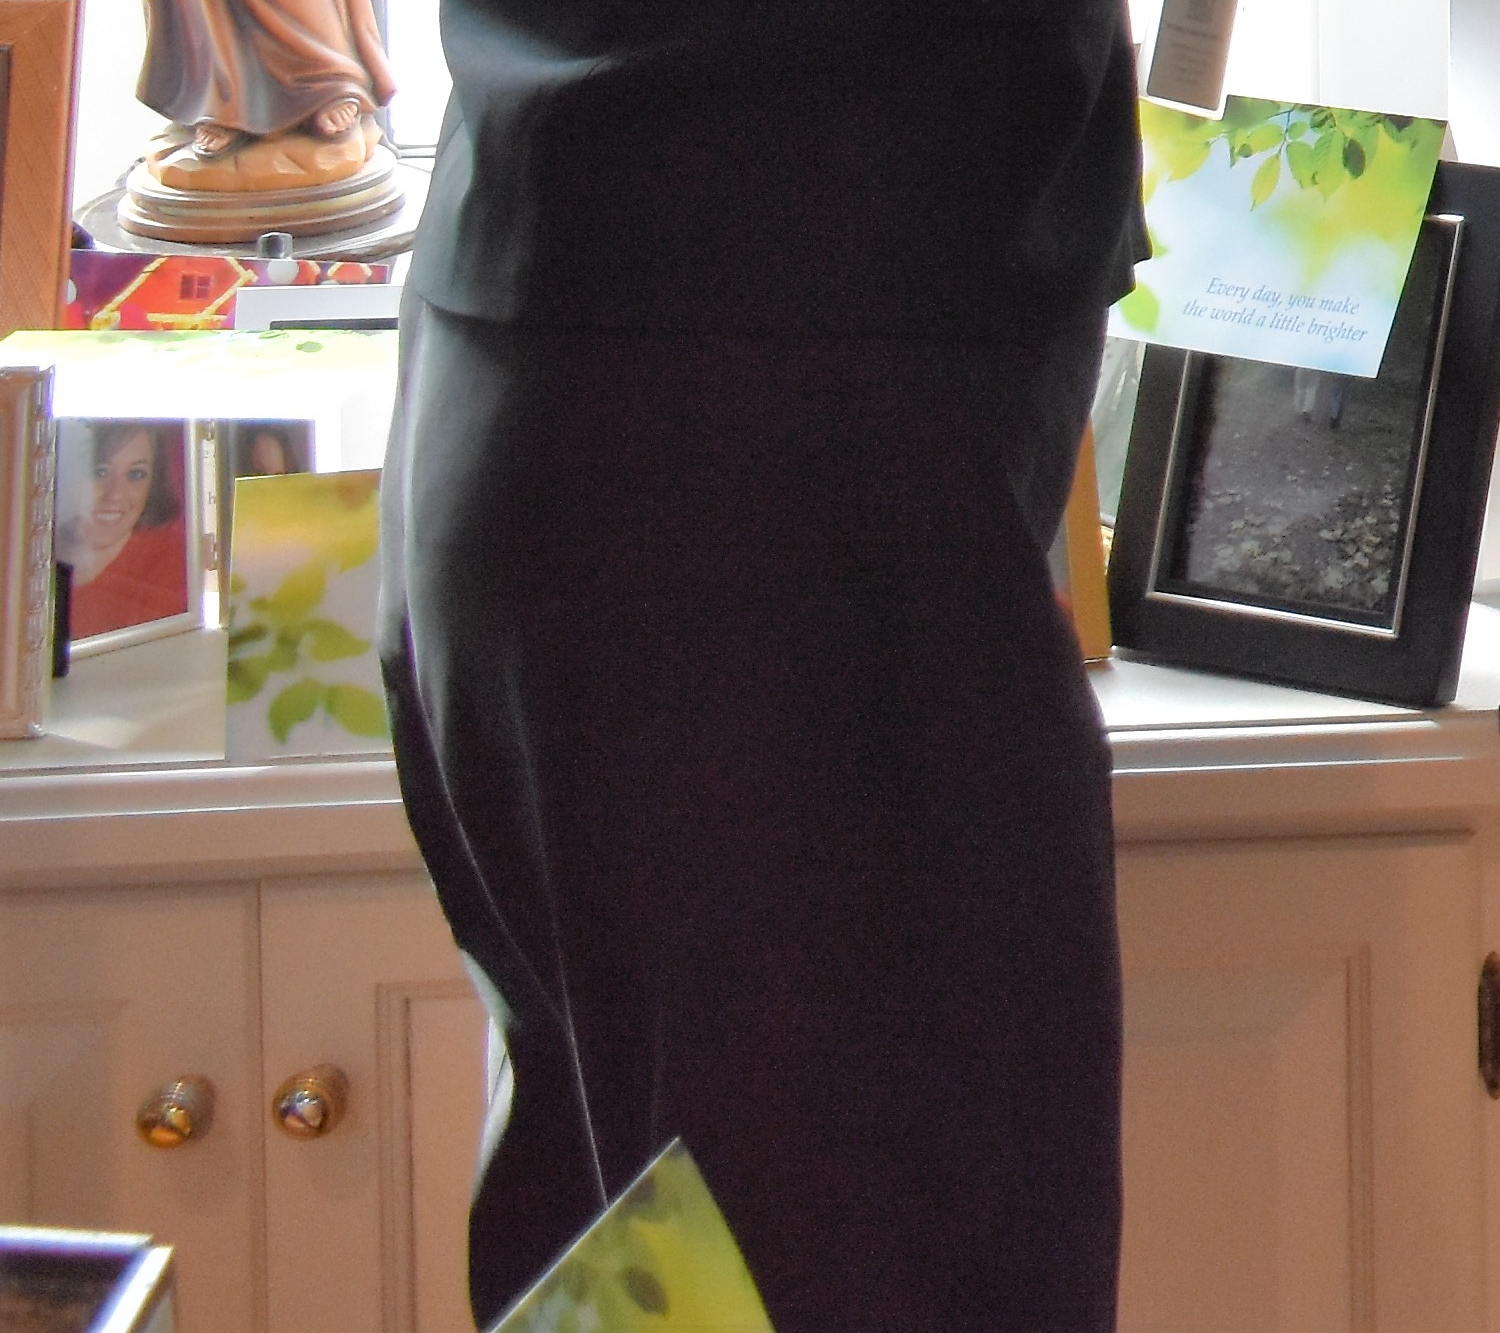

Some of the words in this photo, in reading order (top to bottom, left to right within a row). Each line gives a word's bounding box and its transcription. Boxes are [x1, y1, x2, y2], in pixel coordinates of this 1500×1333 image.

[1205, 275, 1252, 305] Every
[1250, 283, 1285, 310] day,
[1285, 294, 1314, 314] you
[1318, 293, 1360, 316] make
[1182, 297, 1208, 317] the
[1210, 301, 1254, 325] world
[1269, 311, 1304, 332] little
[1305, 316, 1368, 348] brighter
